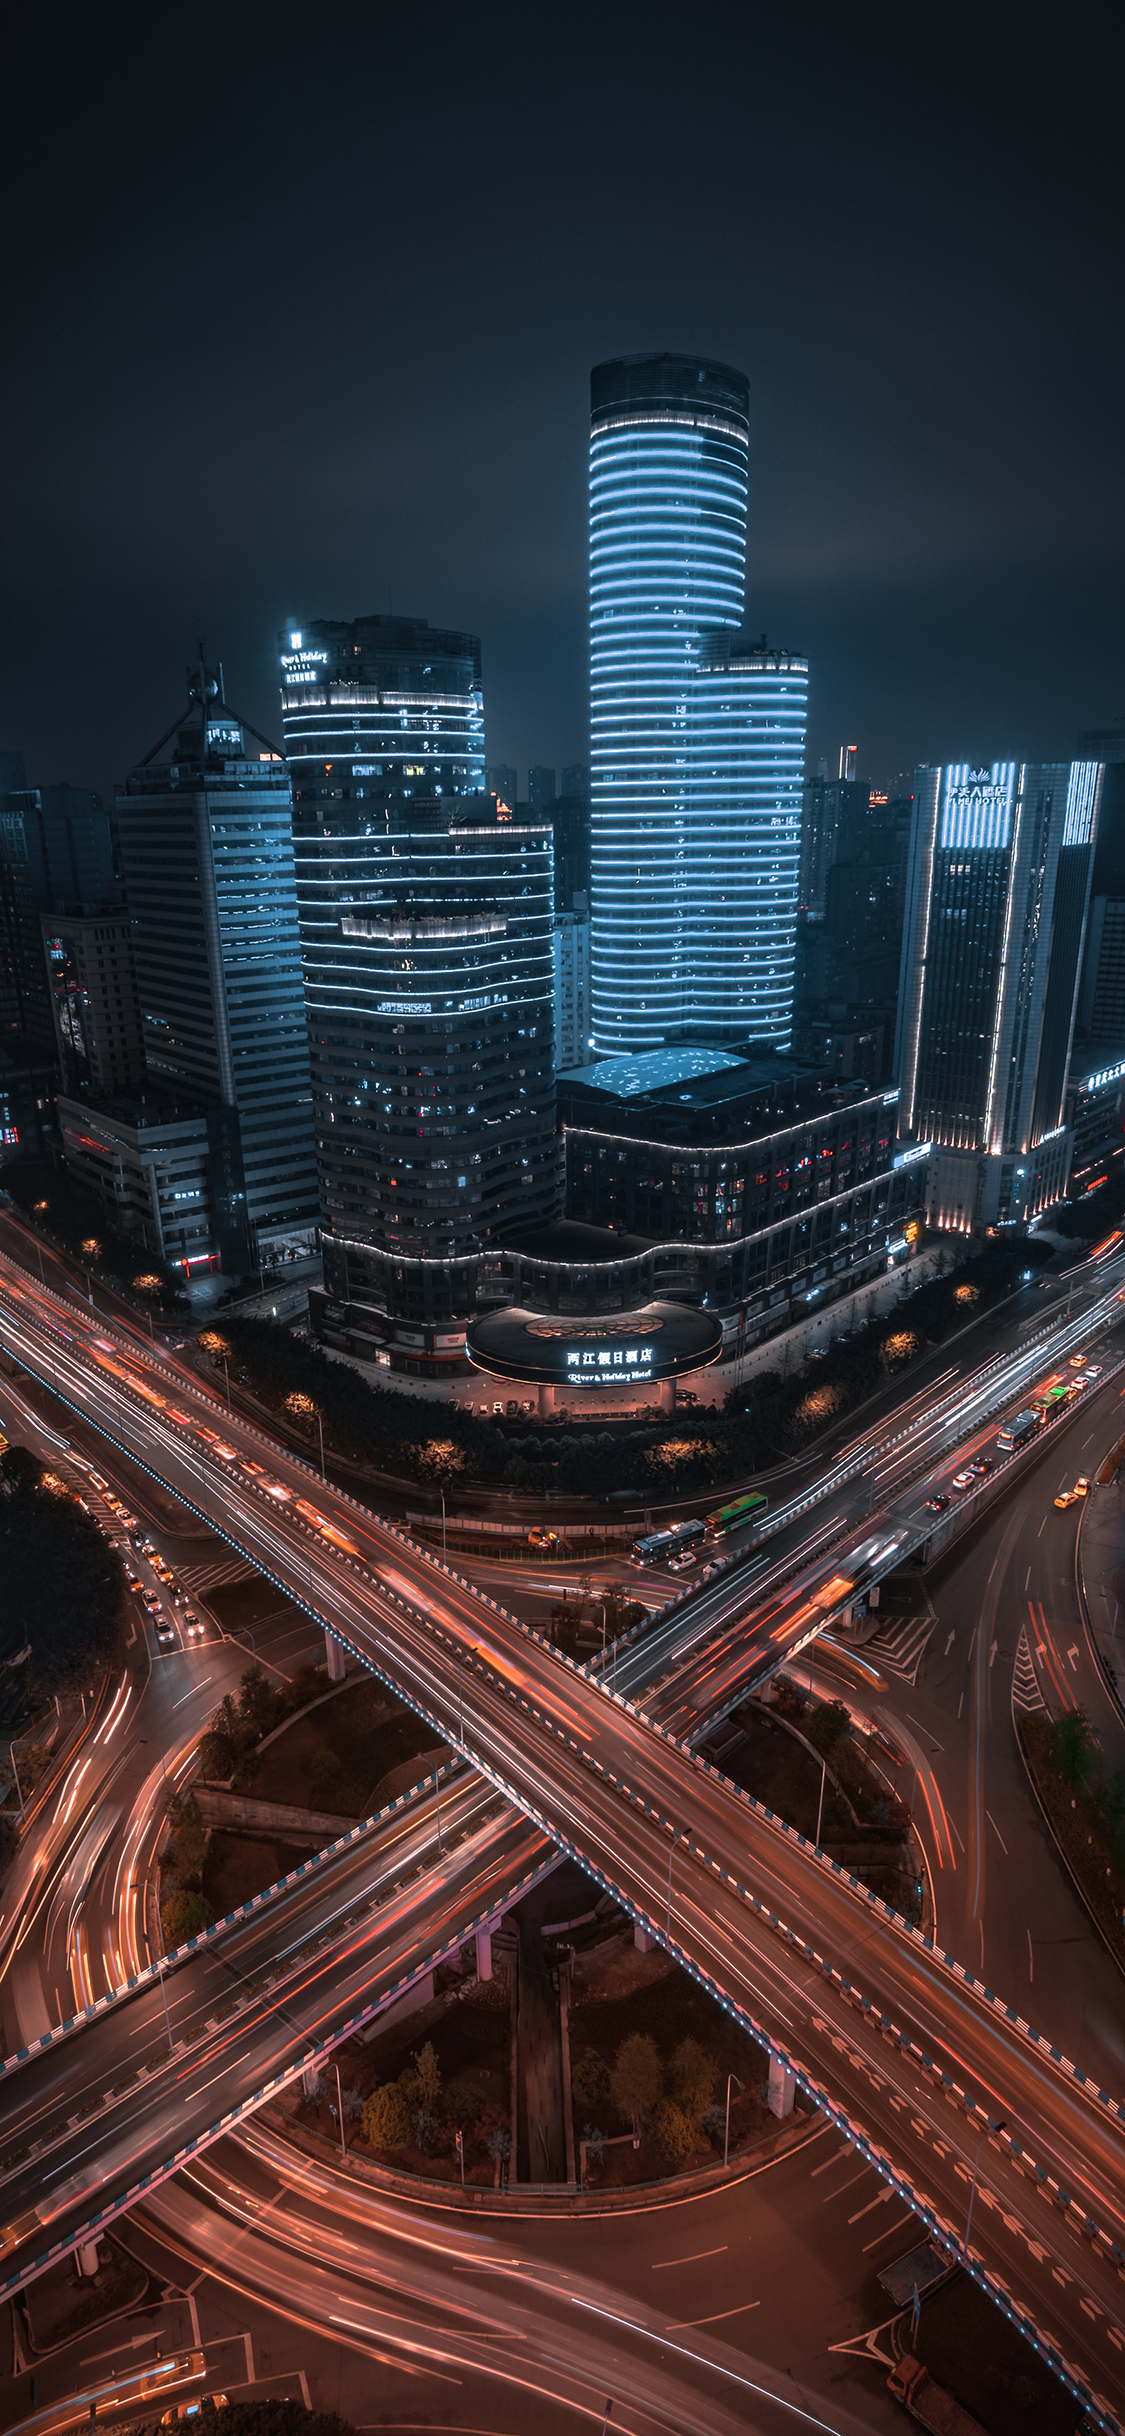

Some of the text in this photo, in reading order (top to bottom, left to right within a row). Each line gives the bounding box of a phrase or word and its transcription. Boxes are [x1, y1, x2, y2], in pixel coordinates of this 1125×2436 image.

[299, 651, 328, 663] Holiday
[567, 1348, 652, 1365] 两江假日酒店
[568, 1373, 594, 1384] River
[602, 1372, 630, 1382] Holiday
[631, 1369, 652, 1379] Hotel
